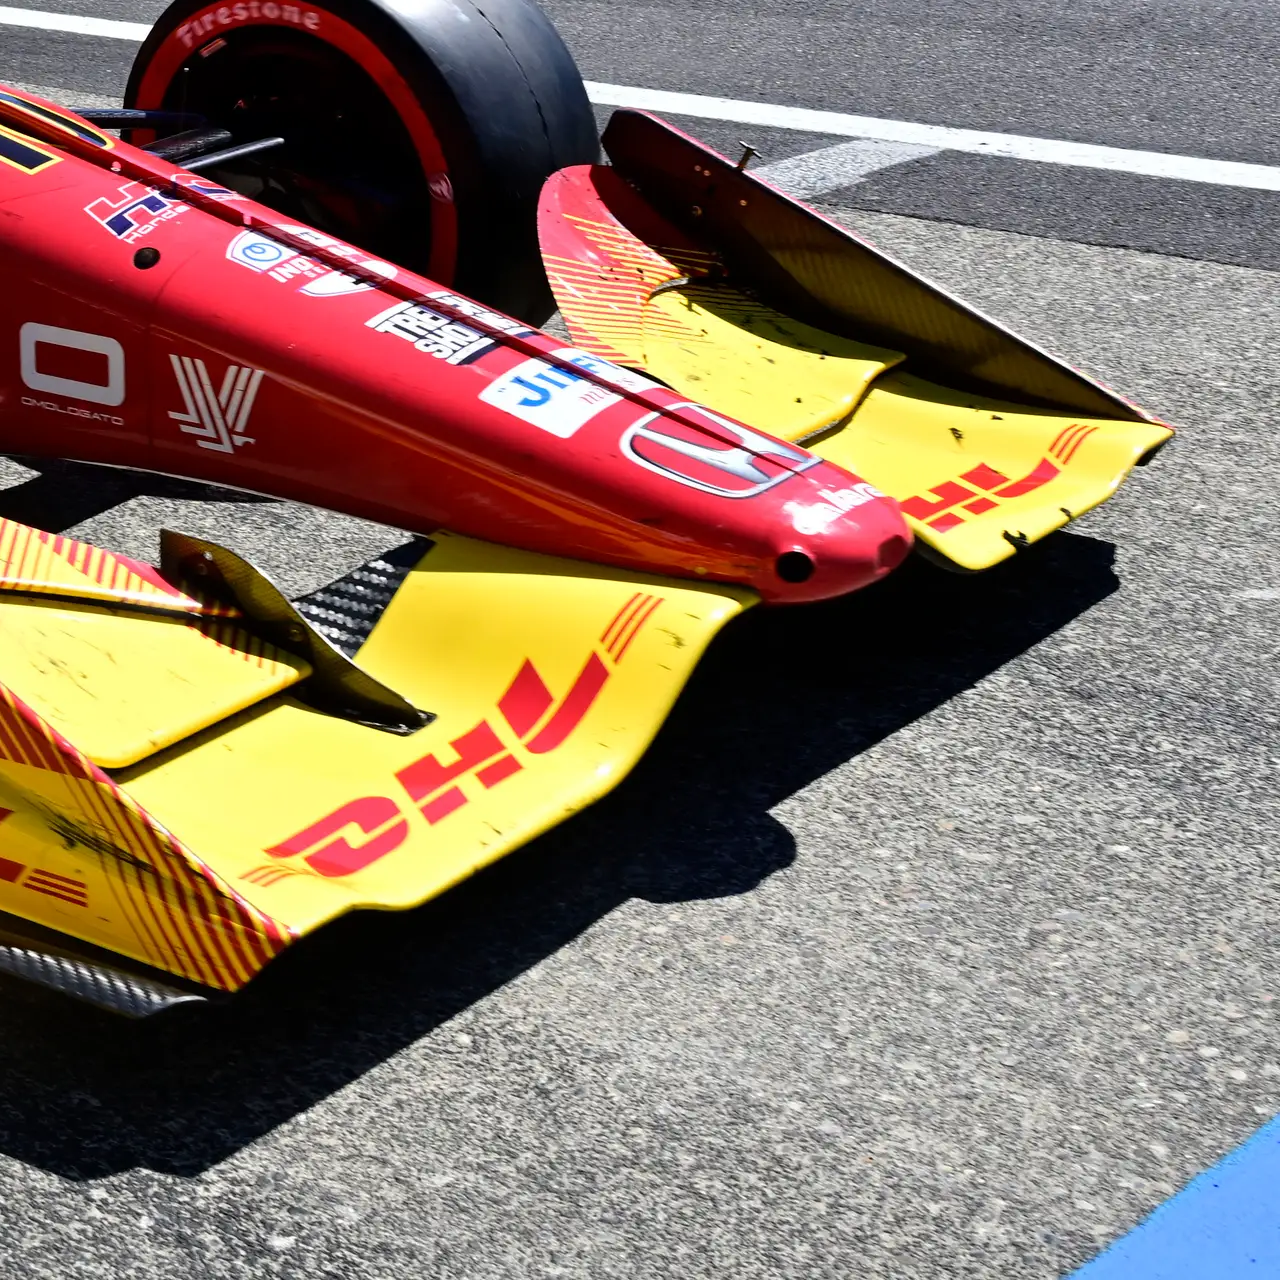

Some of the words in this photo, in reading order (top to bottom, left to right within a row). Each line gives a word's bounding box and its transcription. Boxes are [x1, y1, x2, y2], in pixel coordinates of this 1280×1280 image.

[175, 0, 321, 51] Firestone
[123, 205, 190, 245] Honda
[20, 396, 124, 427] OMOLOGATO
[900, 462, 1062, 533] HL
[263, 649, 610, 878] DHL
